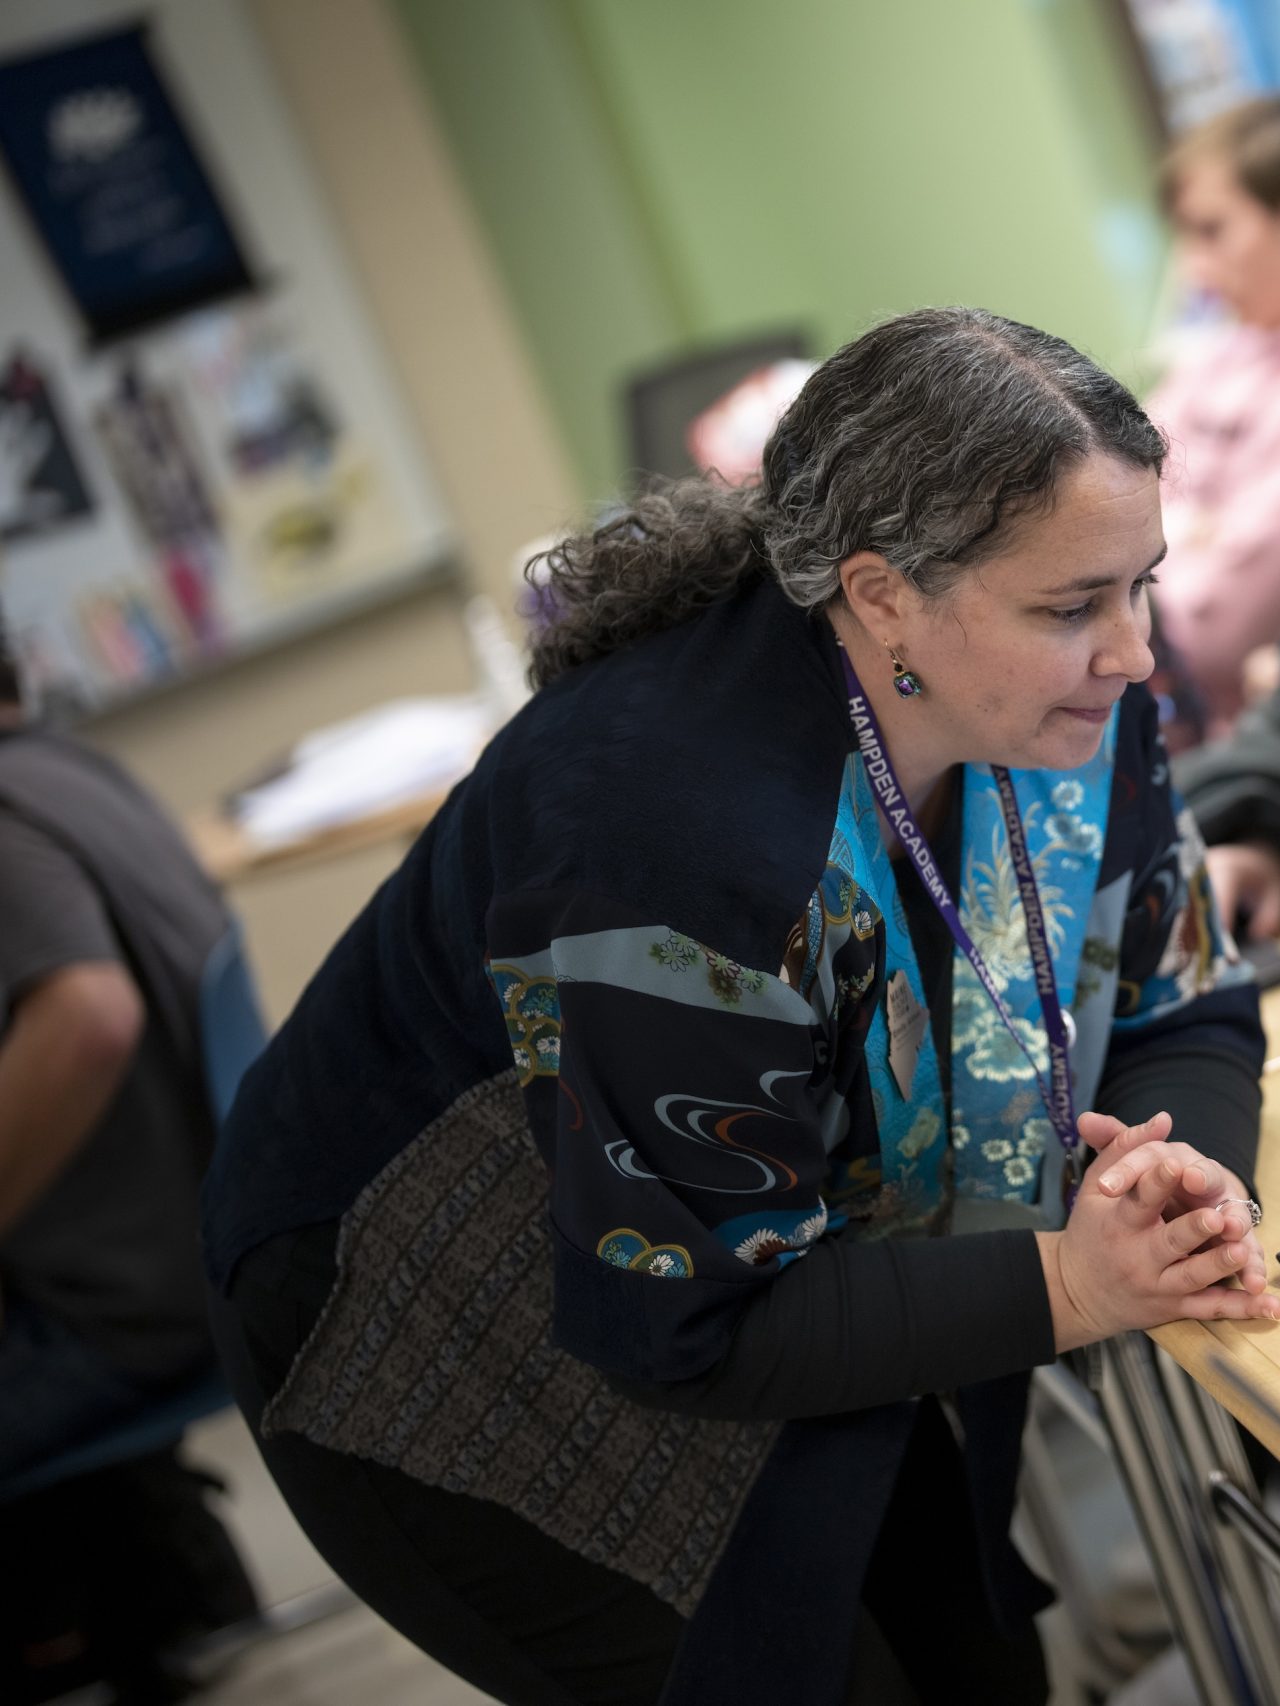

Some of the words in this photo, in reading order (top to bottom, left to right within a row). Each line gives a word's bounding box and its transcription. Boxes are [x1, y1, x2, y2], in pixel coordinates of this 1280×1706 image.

[849, 696, 900, 807] HAMPDEN
[890, 808, 951, 907] ACADEMY
[1021, 882, 1053, 994] HAMPDEN
[1052, 1042, 1073, 1127] ADEMY
